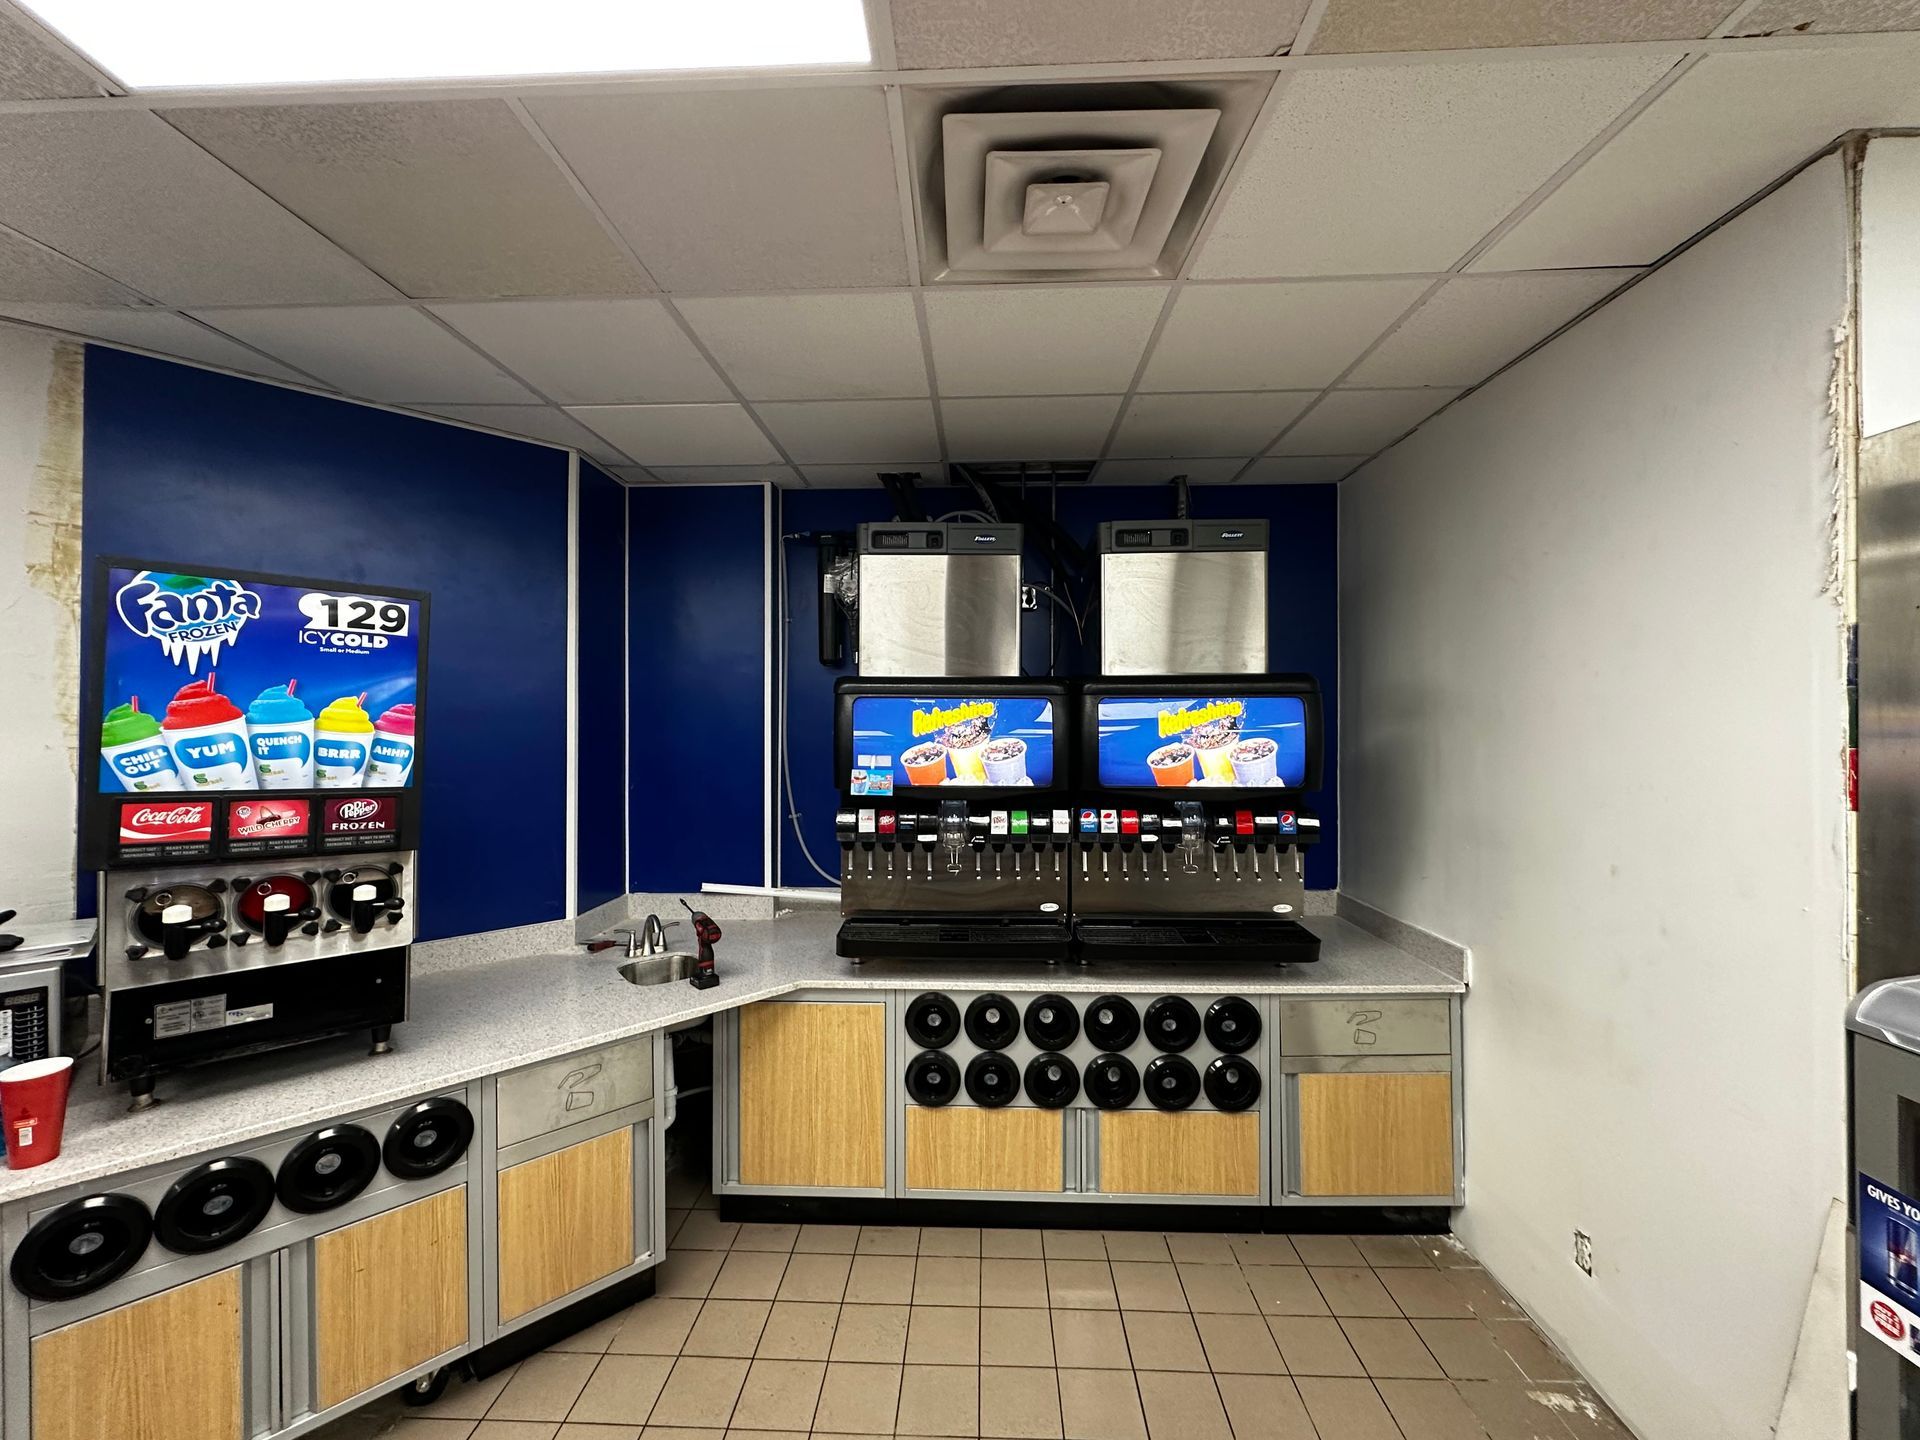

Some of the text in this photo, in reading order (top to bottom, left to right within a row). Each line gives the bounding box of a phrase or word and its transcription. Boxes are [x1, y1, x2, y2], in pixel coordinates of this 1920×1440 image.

[117, 580, 260, 635] Fanta
[320, 598, 407, 633] 129
[168, 621, 239, 643] FROZEN
[256, 735, 302, 746] QUENCH
[119, 748, 168, 767] CHILL
[185, 741, 236, 759] YUM
[258, 747, 269, 756] IT
[317, 747, 361, 760] BRRR
[373, 745, 410, 758] AHHH
[125, 760, 160, 775] OUT
[343, 803, 375, 819] Pepper
[353, 800, 367, 810] Dr
[131, 806, 206, 827] Coca-Cola
[238, 816, 301, 834] WILD CHERRY
[331, 821, 386, 831] FROZEN
[1867, 1184, 1901, 1211] GIVES
